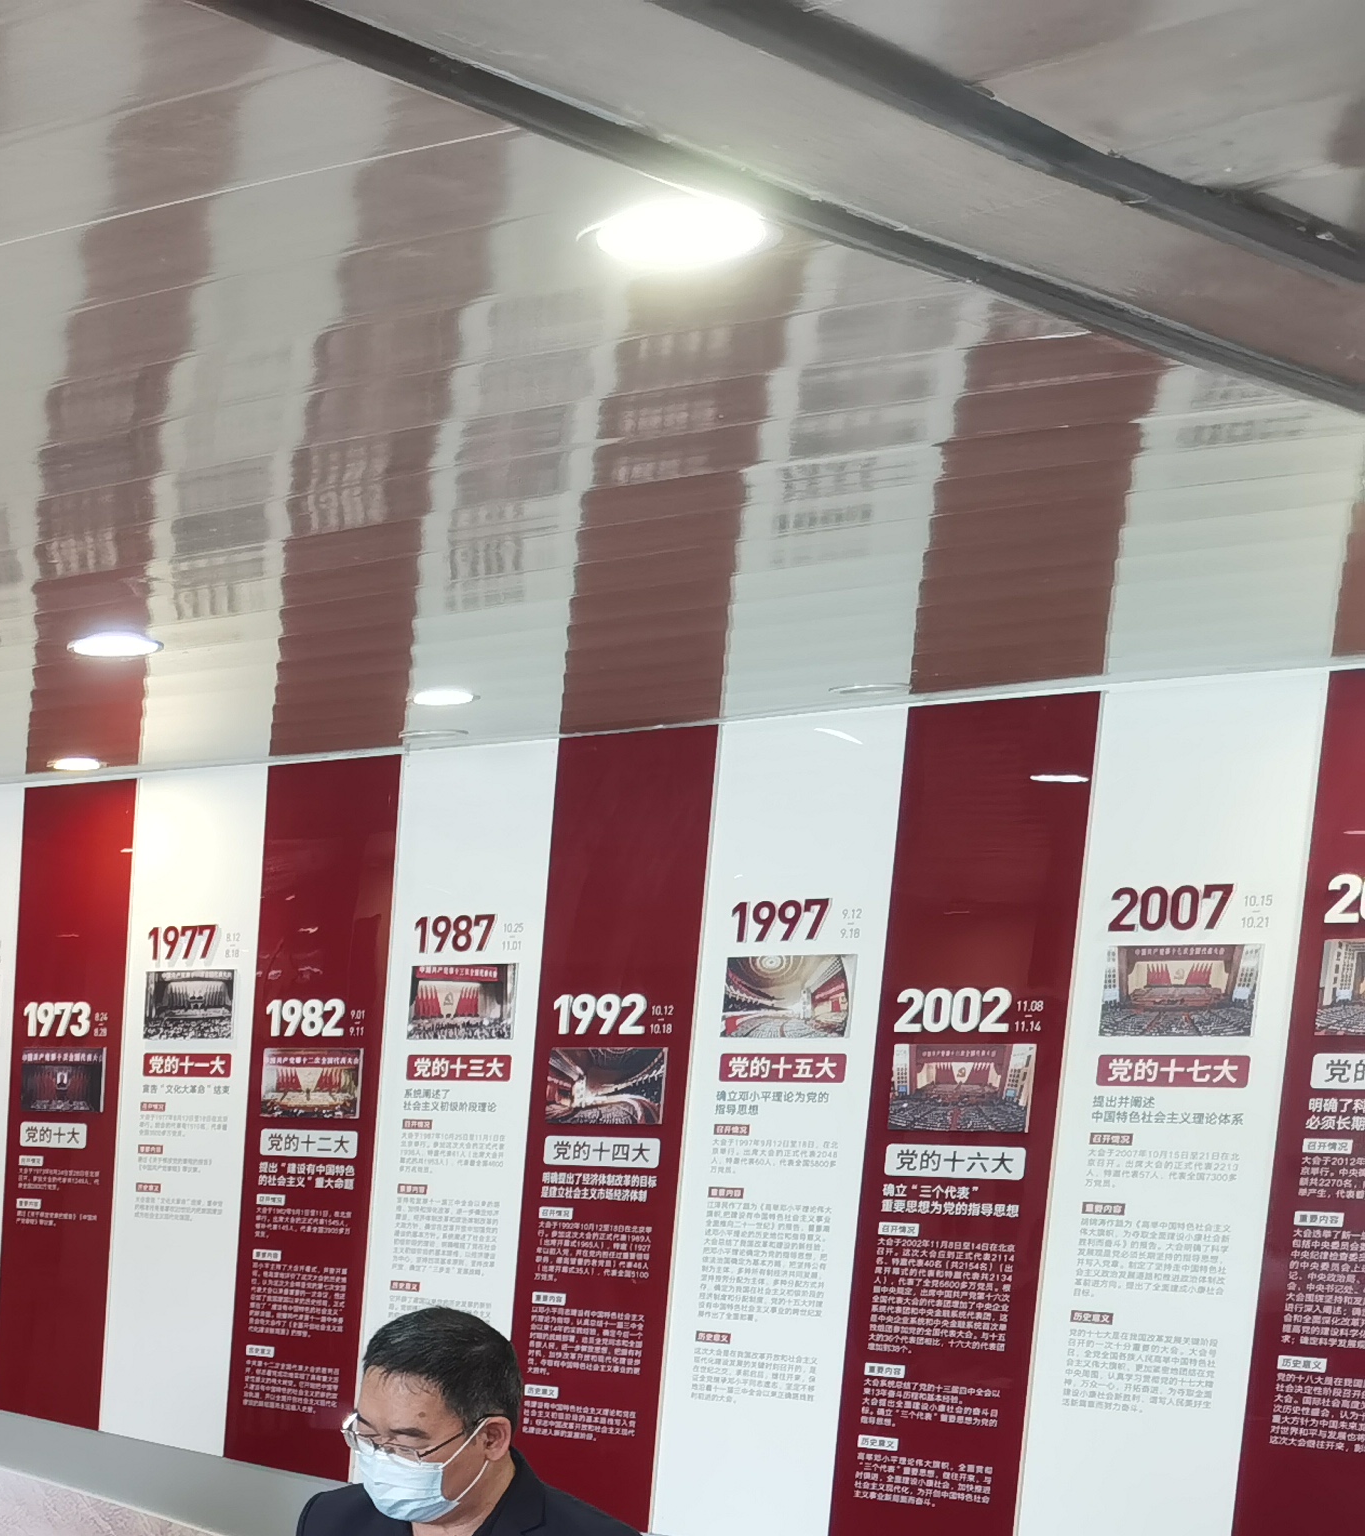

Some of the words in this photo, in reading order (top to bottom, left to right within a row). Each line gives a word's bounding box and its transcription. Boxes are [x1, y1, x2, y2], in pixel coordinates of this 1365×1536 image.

[1244, 894, 1273, 907] 10.15
[1323, 873, 1365, 924] 2
[1107, 883, 1235, 932] 2007
[730, 898, 831, 943] 1997
[841, 909, 862, 920] 9.12
[503, 923, 524, 933] 10.25
[1241, 916, 1270, 929] 10.21
[226, 933, 241, 942] 8.12
[414, 913, 498, 954] 1987
[839, 927, 861, 939] 9.18
[148, 924, 217, 961] 1977
[502, 941, 522, 951] 11.01
[225, 949, 239, 958] 8.18
[651, 1004, 674, 1016] 10.12
[894, 986, 1013, 1033] 2002
[1016, 1001, 1044, 1012] 11.08
[23, 1001, 92, 1037] 1973
[266, 998, 346, 1037] 1982
[350, 1010, 365, 1020] 9.01
[554, 993, 648, 1036] 1992
[349, 1027, 364, 1036] 9.11
[650, 1023, 673, 1034] 10.18
[1014, 1021, 1041, 1032] 11.14
[149, 1056, 226, 1074] 党的十一大
[414, 1058, 504, 1078] 党的十三大
[727, 1056, 837, 1080] 党的十五大
[1107, 1058, 1239, 1084] 党的十七大
[403, 1088, 450, 1100] 系统阐述了
[715, 1090, 829, 1104] 确立邓小平理论为党的
[402, 1100, 497, 1112] 社会主义初级阶段理论
[1092, 1095, 1156, 1108] 提出并阐述
[714, 1103, 759, 1116] 指导思想
[1091, 1111, 1244, 1126] 中国特色社会主义理论体系
[25, 1126, 80, 1144] 党的十大
[1092, 1134, 1131, 1144] 召开情况
[268, 1133, 350, 1154] 党的十二大
[1306, 1141, 1349, 1152] 召开情况
[553, 1141, 651, 1163] 党的十四大
[896, 1149, 1014, 1174] 党的十六大
[258, 1162, 355, 1177] 提出“建设有中国特色
[258, 1176, 354, 1190] 的社会主义”重大命题
[542, 1171, 657, 1188] 明确提出了经济体制改革的目标
[541, 1186, 648, 1202] 是建立社会主义市场经济体制
[882, 1183, 979, 1199] 确立“三个代表”
[881, 1199, 1020, 1218] 重要思想为党的指导思想
[1299, 1214, 1339, 1224] 重要内容
[881, 1224, 916, 1234] 召开情况
[1073, 1312, 1110, 1323] 历史意义
[868, 1366, 901, 1375] 重要内容
[1282, 1358, 1322, 1370] 历史意义
[861, 1437, 895, 1449] 历史意义
